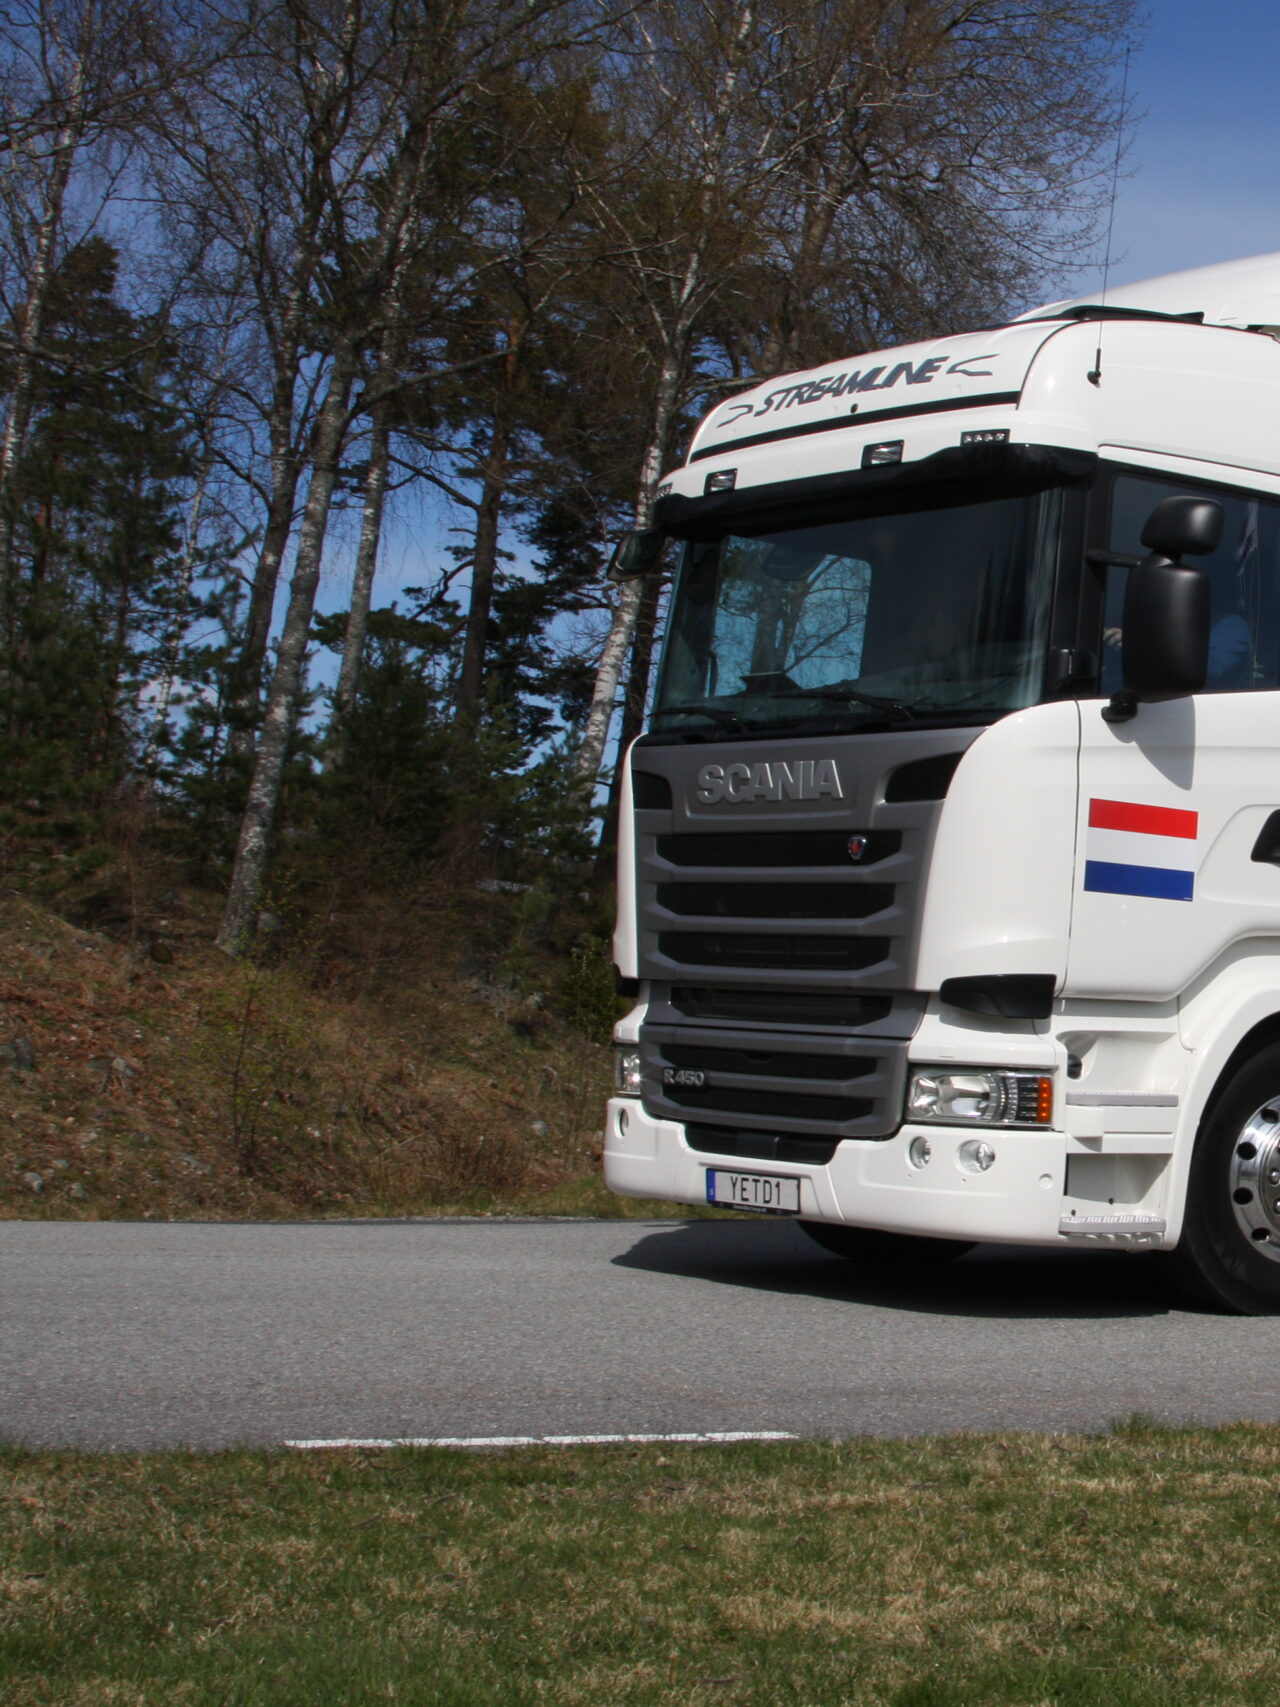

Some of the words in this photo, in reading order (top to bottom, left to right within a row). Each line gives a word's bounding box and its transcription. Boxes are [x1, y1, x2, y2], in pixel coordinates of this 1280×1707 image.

[754, 356, 950, 417] STREAMLINE
[697, 759, 844, 804] SCANIA
[663, 1069, 675, 1084] R
[675, 1070, 705, 1087] 450
[730, 1176, 780, 1205] YETD1
